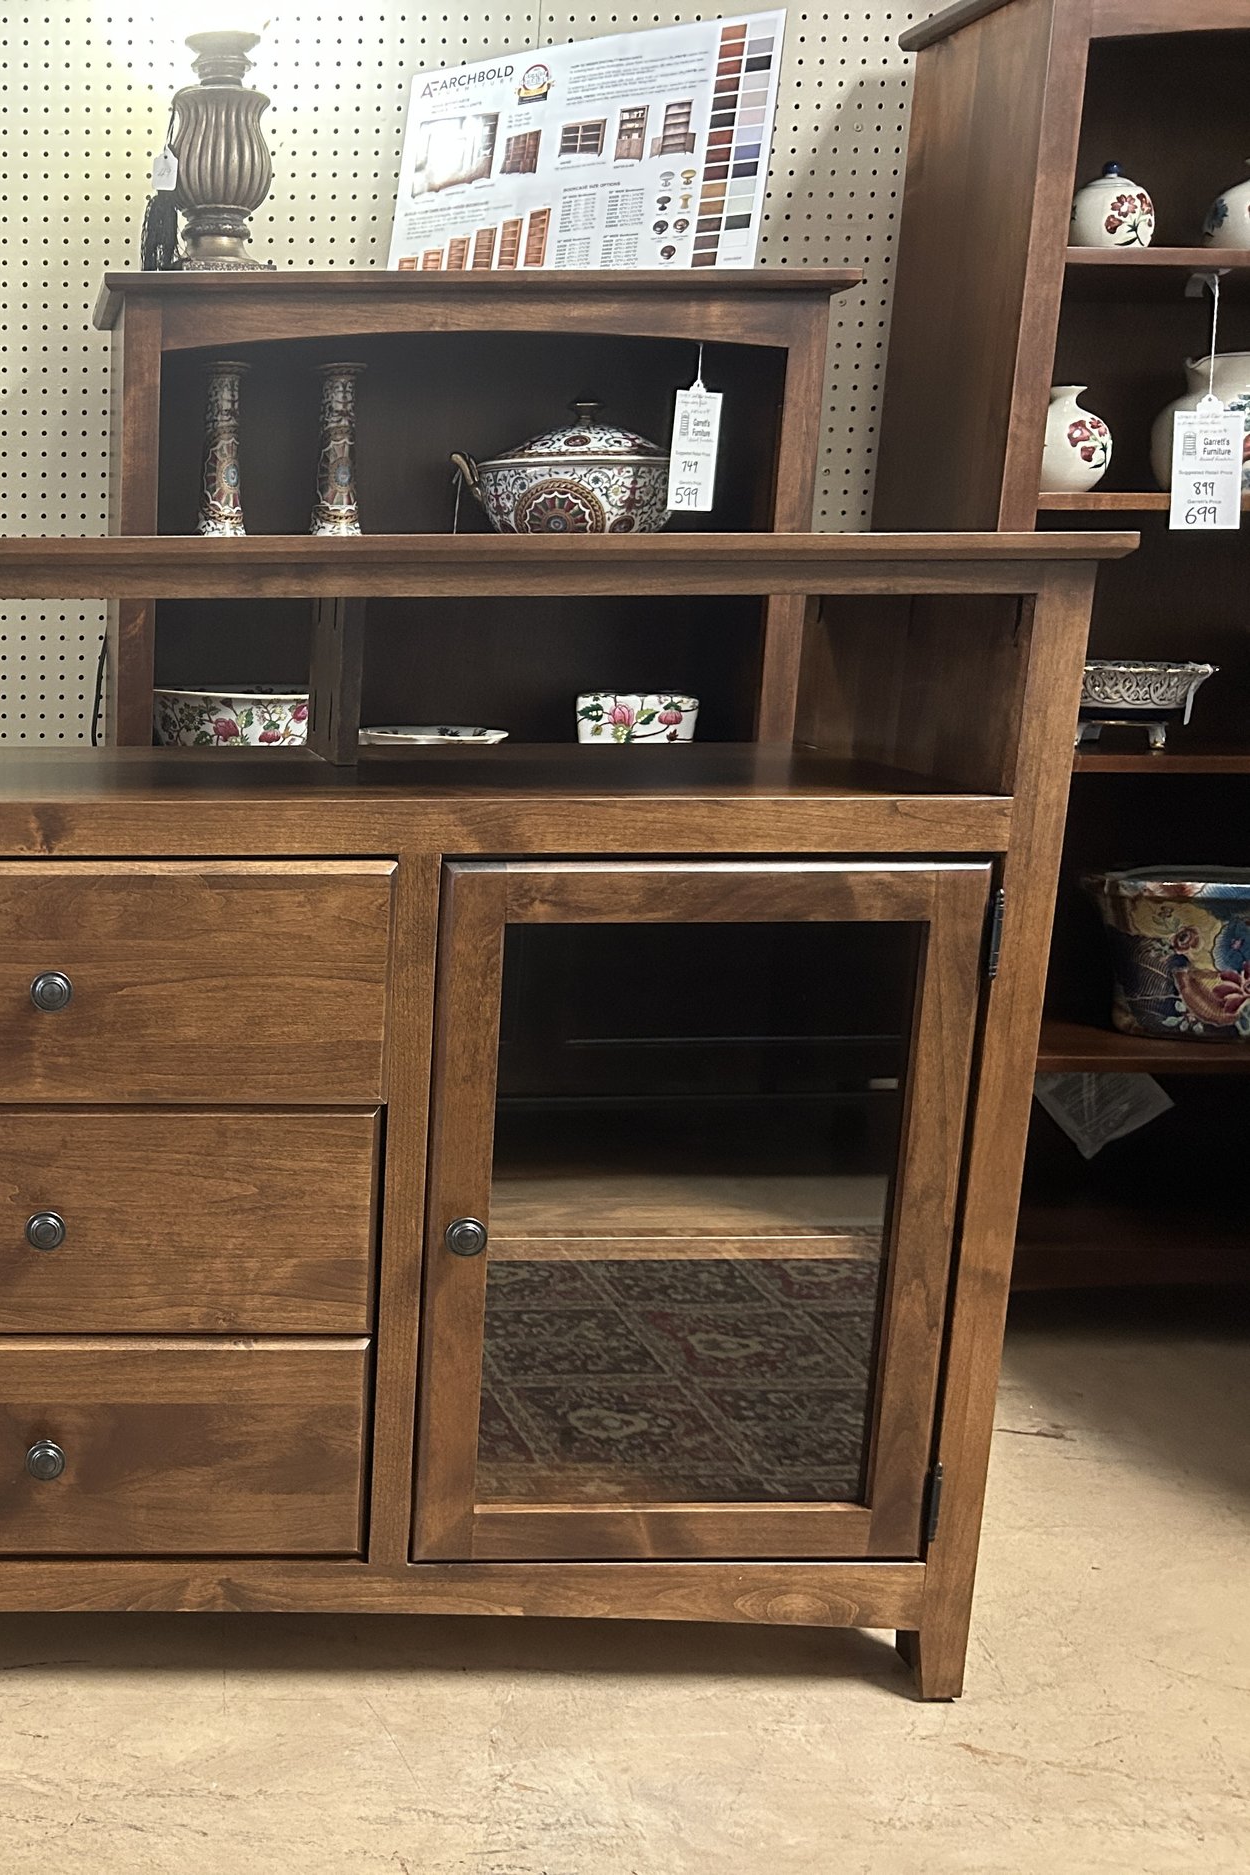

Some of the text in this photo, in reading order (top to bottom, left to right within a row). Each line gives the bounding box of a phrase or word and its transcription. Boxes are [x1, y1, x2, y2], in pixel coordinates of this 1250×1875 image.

[439, 65, 514, 91] ARCHBOLD
[1202, 447, 1231, 456] Furniture
[682, 460, 699, 473] 749
[675, 486, 699, 508] 599
[1193, 481, 1215, 497] 899
[1185, 506, 1217, 525] 699
